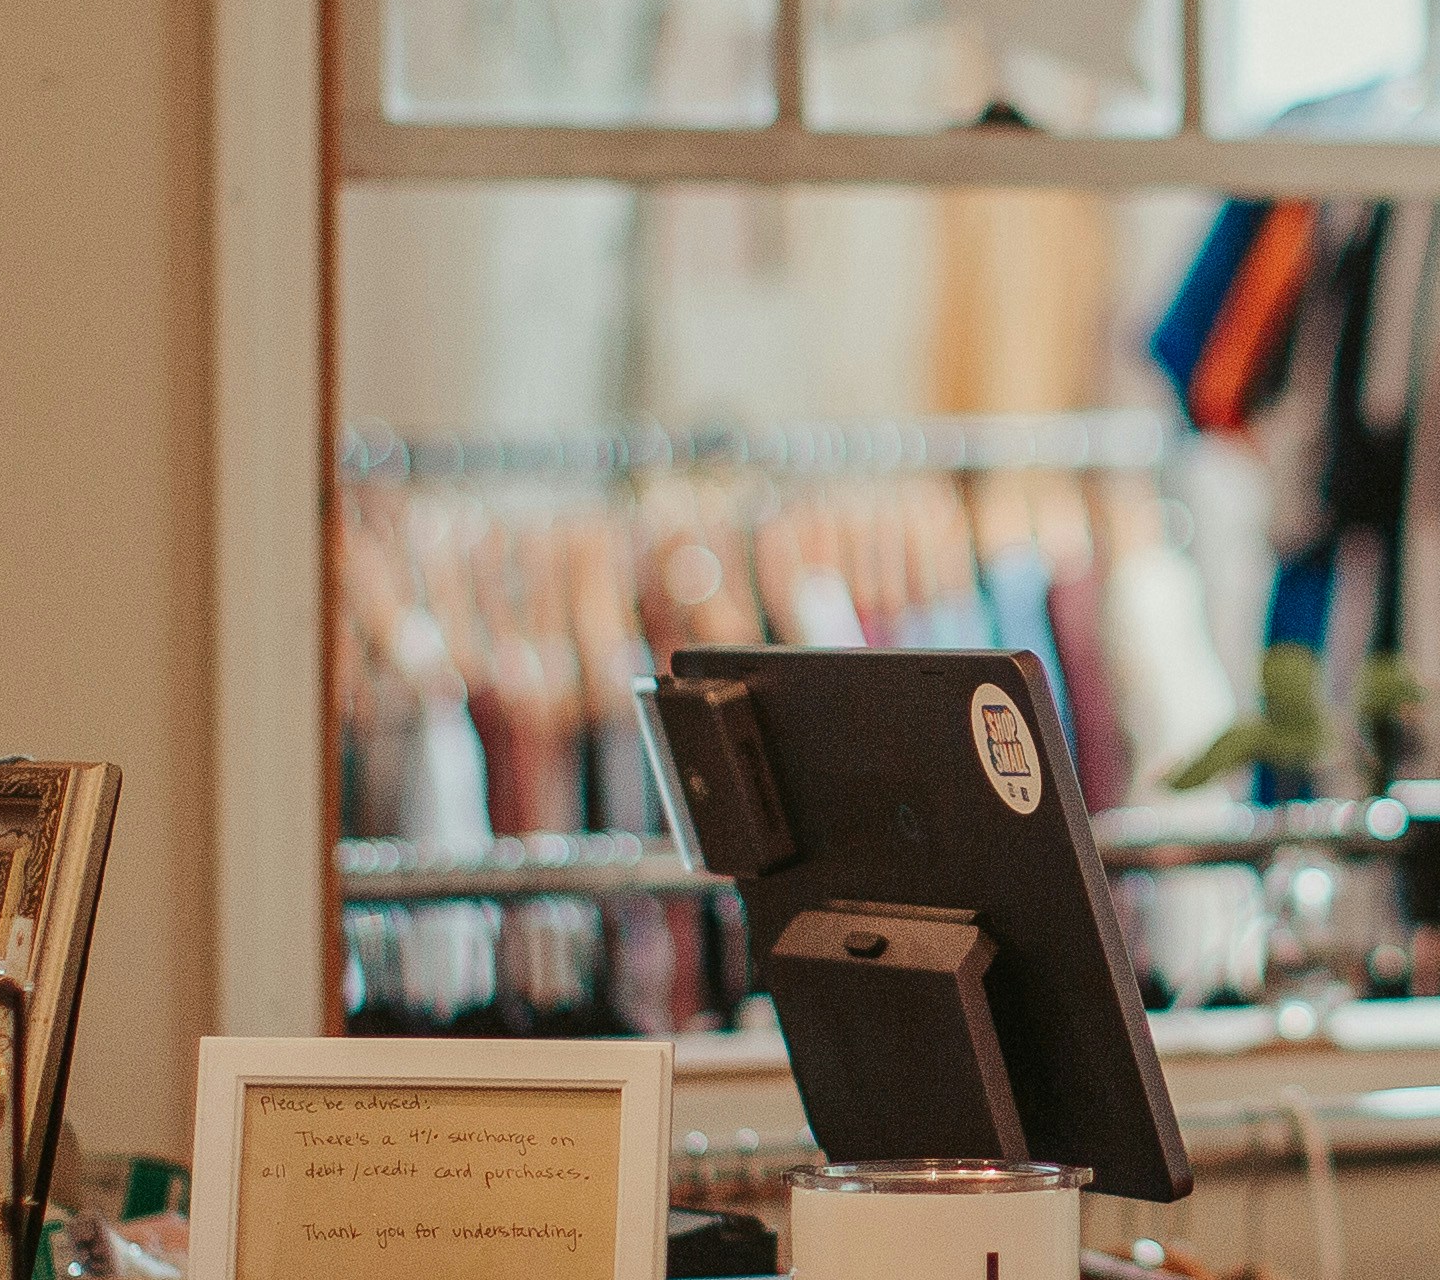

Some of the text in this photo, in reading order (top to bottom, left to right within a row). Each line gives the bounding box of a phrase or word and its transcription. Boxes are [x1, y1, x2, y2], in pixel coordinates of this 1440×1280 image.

[982, 705, 1017, 744] SHOP
[260, 1095, 318, 1114] Please
[325, 1097, 344, 1112] be
[295, 1128, 576, 1157] There's a 4% surcharge on
[261, 1163, 287, 1179] all
[434, 1163, 472, 1180] card
[484, 1166, 591, 1189] purchases.
[302, 1221, 584, 1252] Thank you for understanding.
